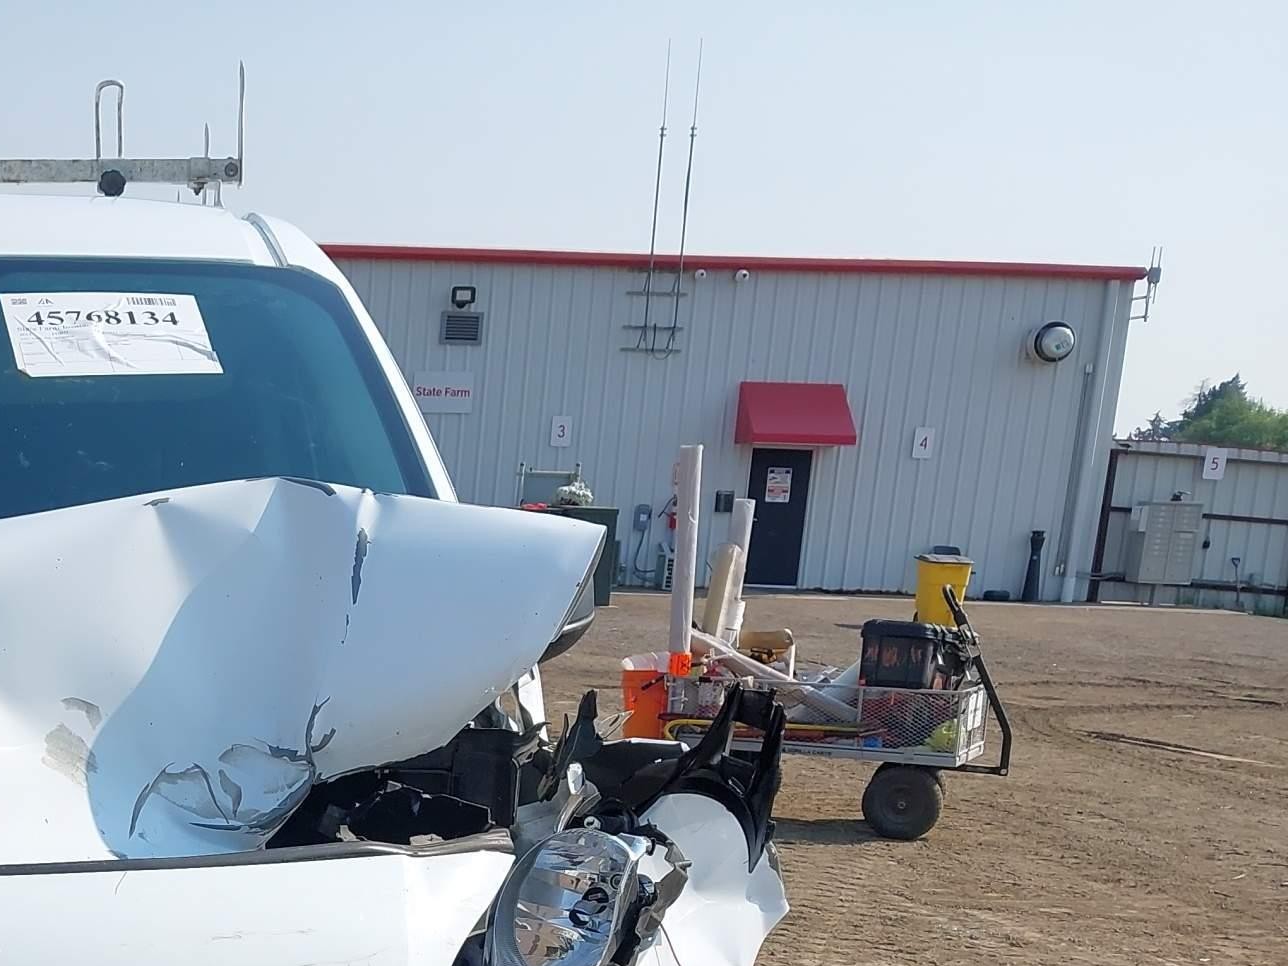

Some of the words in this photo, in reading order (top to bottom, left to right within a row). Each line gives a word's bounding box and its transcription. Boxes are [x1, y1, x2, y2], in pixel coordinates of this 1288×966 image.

[26, 310, 179, 326] 45768134
[415, 386, 442, 397] State
[444, 387, 471, 398] Farm
[557, 424, 566, 438] 3
[919, 435, 928, 450] 4
[1210, 456, 1220, 471] 5
